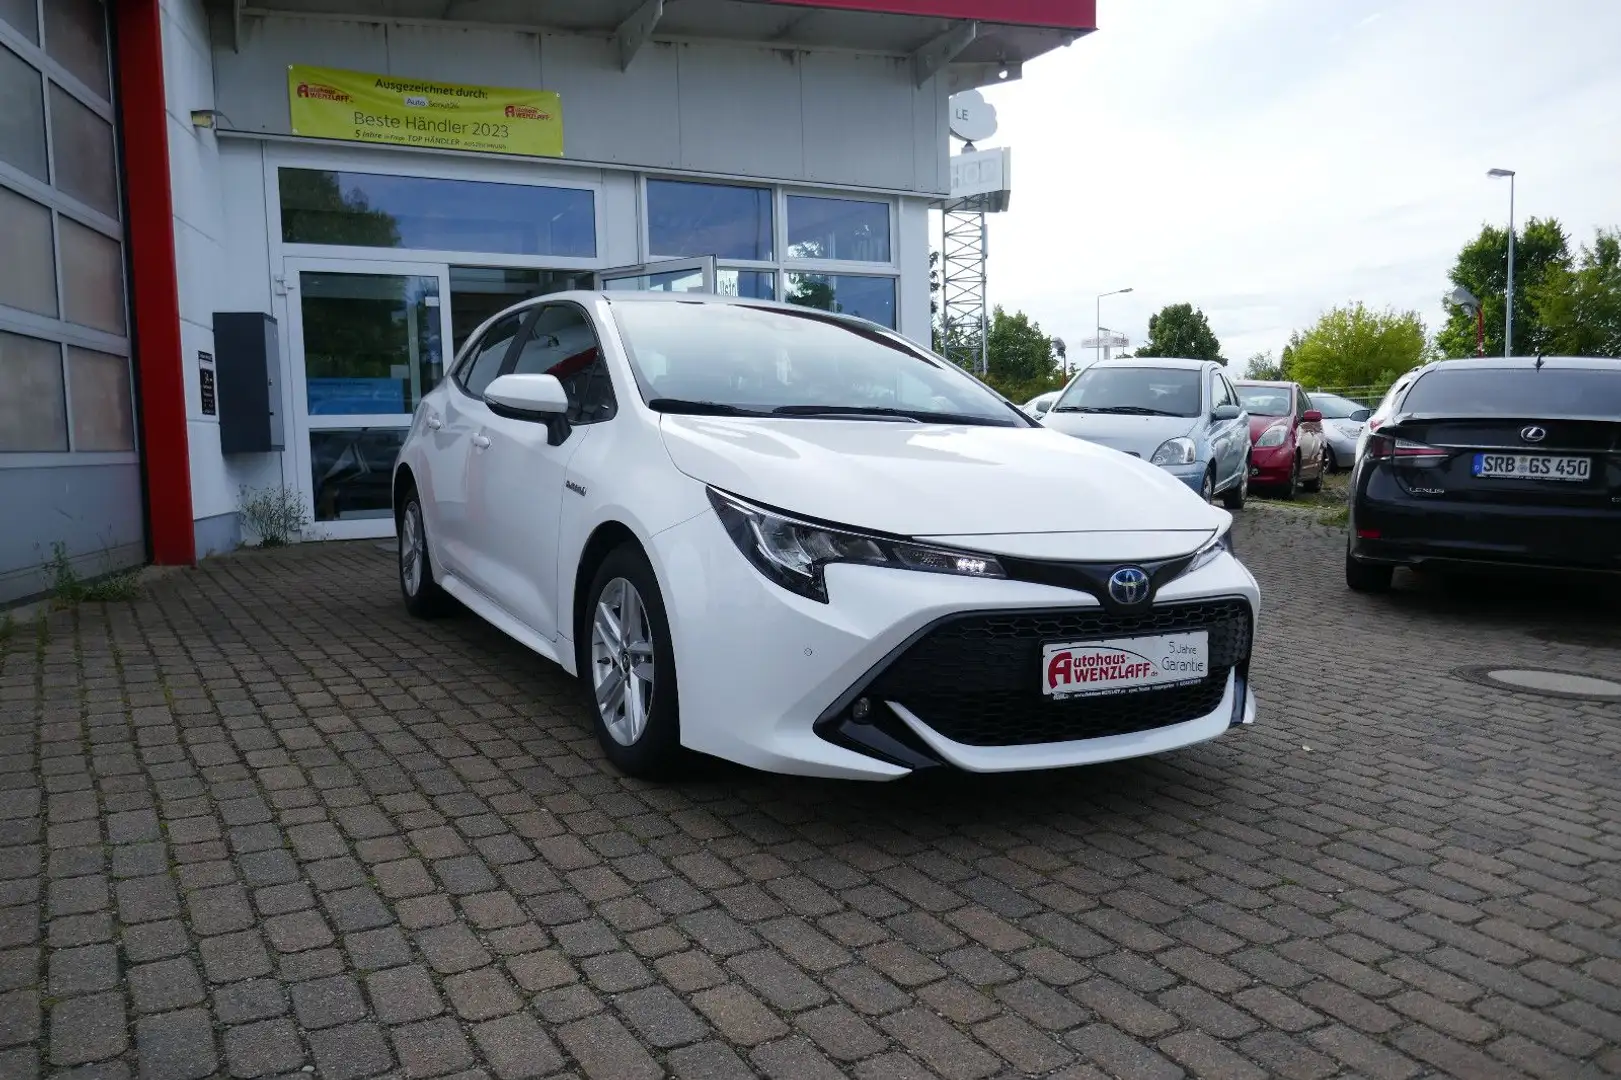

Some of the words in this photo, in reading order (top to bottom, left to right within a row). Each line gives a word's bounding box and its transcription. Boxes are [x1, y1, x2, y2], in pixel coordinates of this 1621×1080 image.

[375, 79, 454, 96] Ausgezeichnet
[456, 87, 488, 99] durch:
[406, 98, 426, 107] Auto
[354, 111, 401, 130] Beste
[405, 117, 468, 134] Händler
[472, 122, 509, 138] 2023
[1483, 456, 1515, 472] SRB
[1529, 458, 1551, 474] GS
[1556, 459, 1588, 476] 450
[1168, 641, 1175, 654] 5
[1176, 644, 1197, 655] Jahre
[1161, 656, 1204, 672] Garantie
